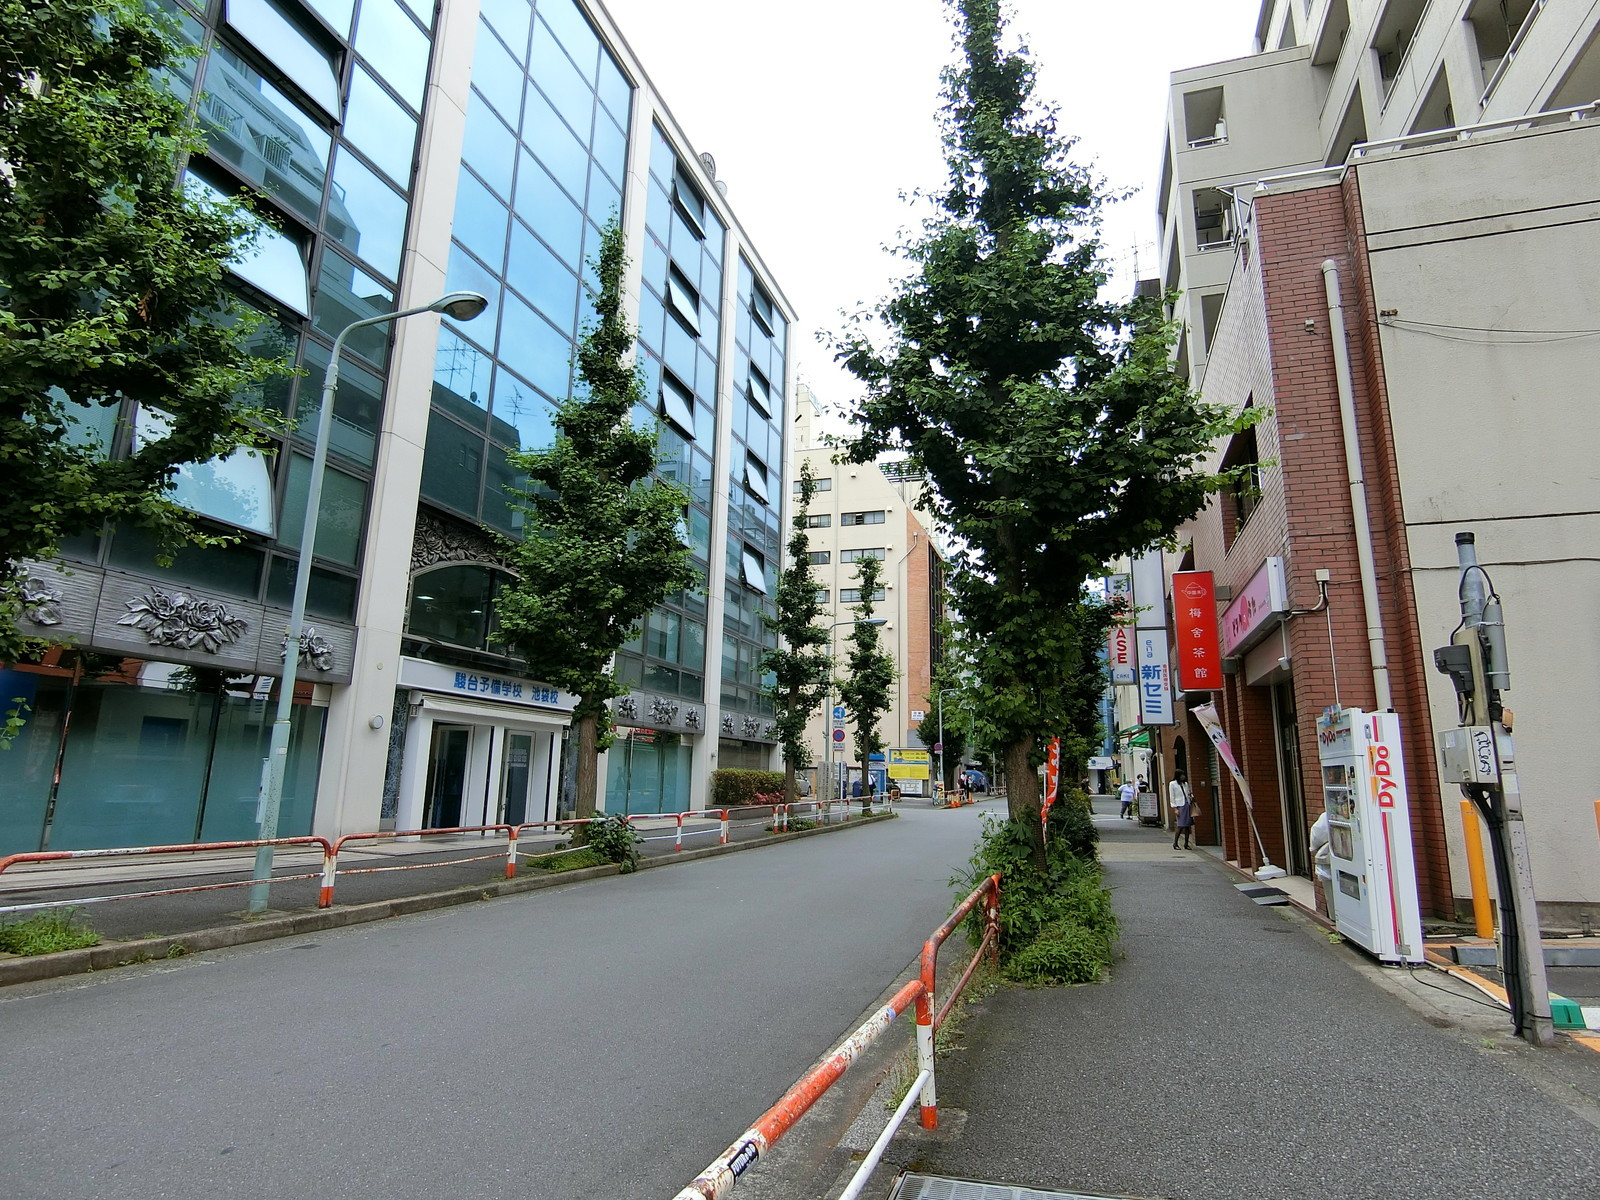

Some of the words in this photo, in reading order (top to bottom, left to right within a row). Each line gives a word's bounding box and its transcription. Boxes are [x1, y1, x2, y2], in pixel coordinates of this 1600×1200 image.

[454, 671, 522, 699] 駿台予備学校
[531, 686, 559, 704] 池袋校
[1141, 664, 1162, 714] 新セミ
[1376, 745, 1397, 808] DyDo
